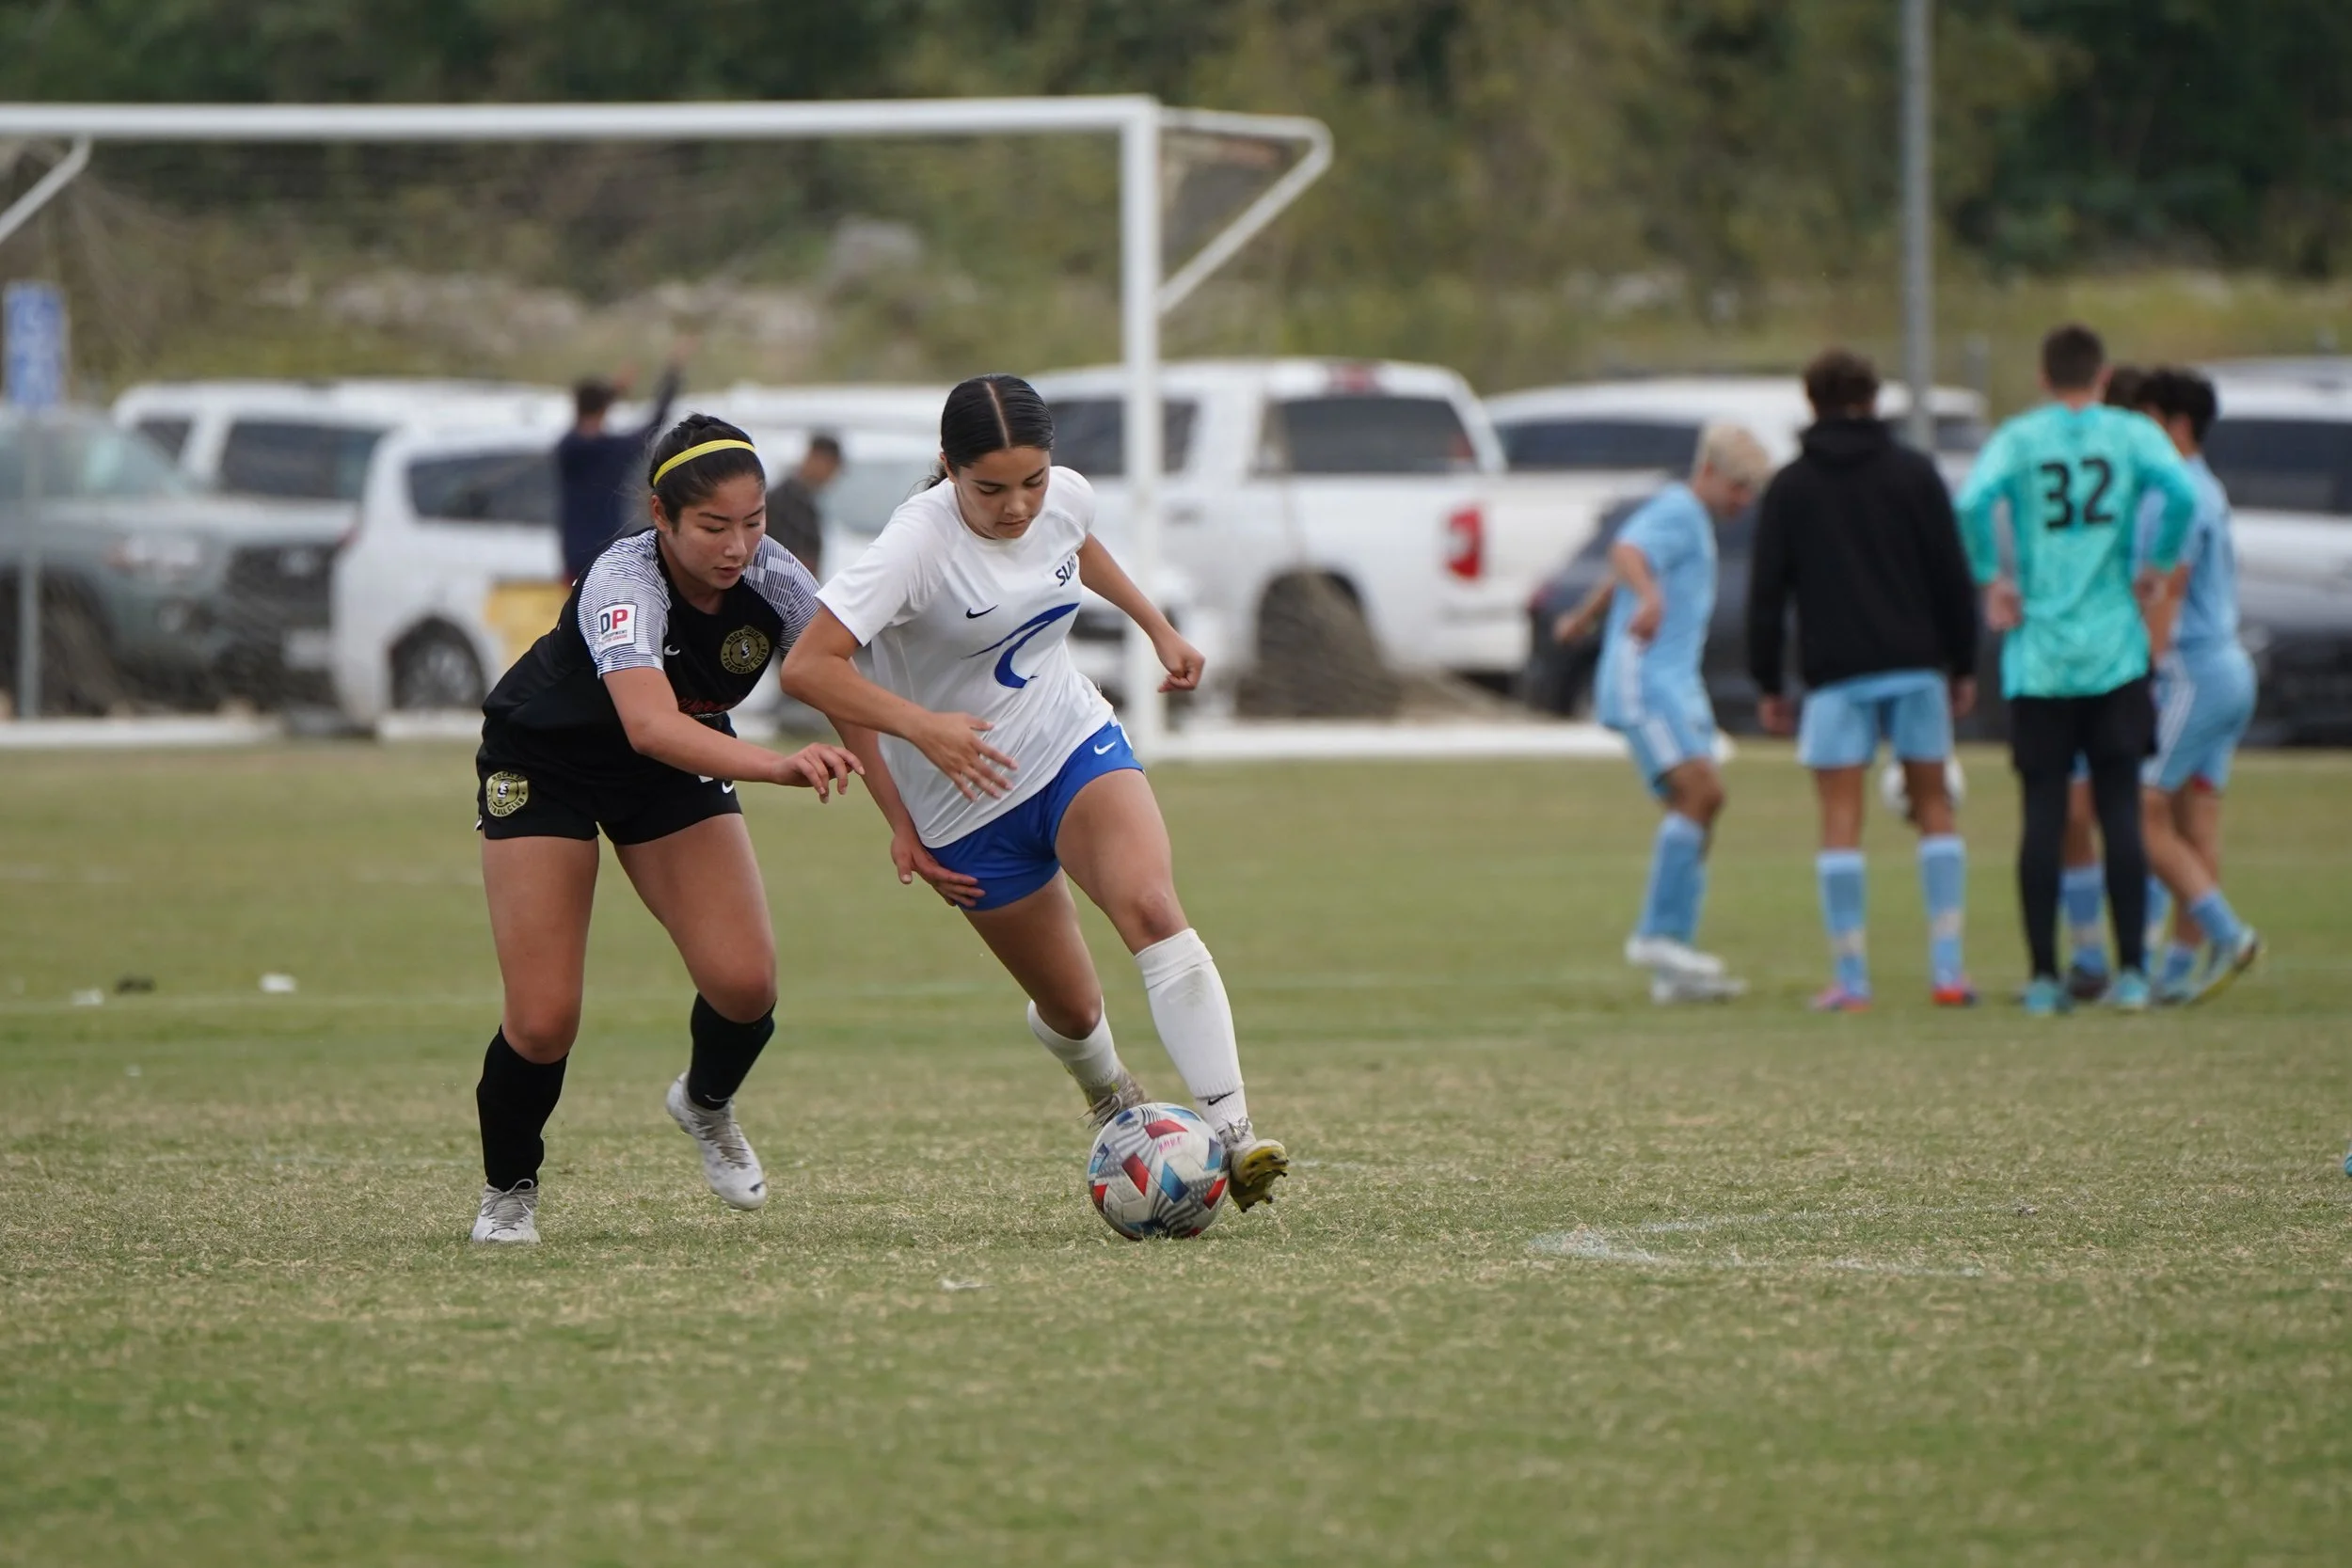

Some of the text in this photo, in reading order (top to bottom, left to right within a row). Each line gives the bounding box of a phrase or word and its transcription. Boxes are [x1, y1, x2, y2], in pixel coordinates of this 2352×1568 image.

[2040, 456, 2115, 530] 32
[600, 609, 628, 634] DP
[753, 648, 768, 665] CLUB
[507, 798, 525, 812] CLUB
